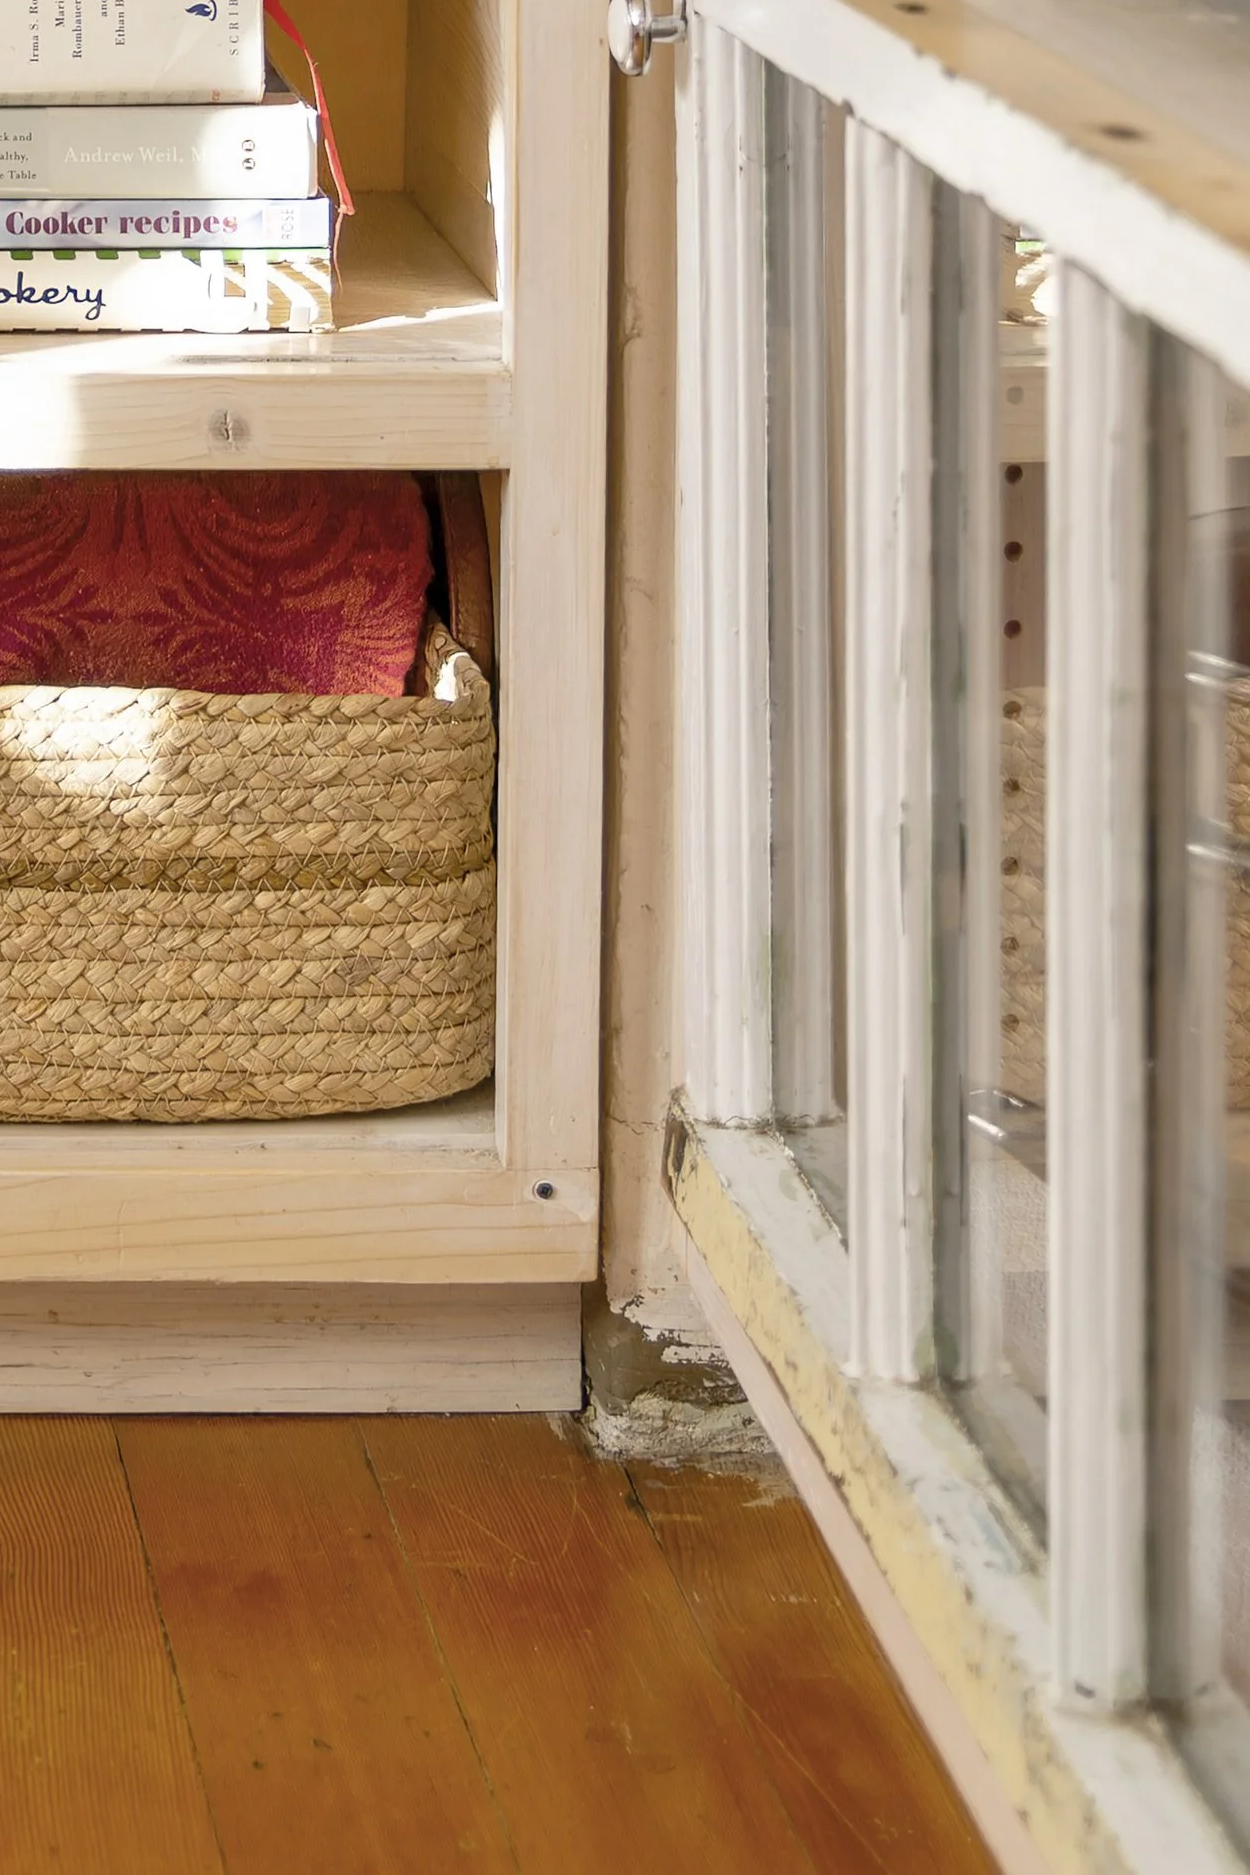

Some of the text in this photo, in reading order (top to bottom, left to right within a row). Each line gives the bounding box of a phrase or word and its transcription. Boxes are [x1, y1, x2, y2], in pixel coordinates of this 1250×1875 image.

[30, 18, 39, 30] S.
[114, 5, 125, 46] Ethan
[30, 41, 40, 63] Irma
[12, 132, 33, 142] and
[64, 147, 134, 163] Andrew
[139, 147, 184, 165] Weil,
[7, 170, 37, 180] Table
[5, 211, 108, 235] Cooker
[119, 210, 238, 239] recipes
